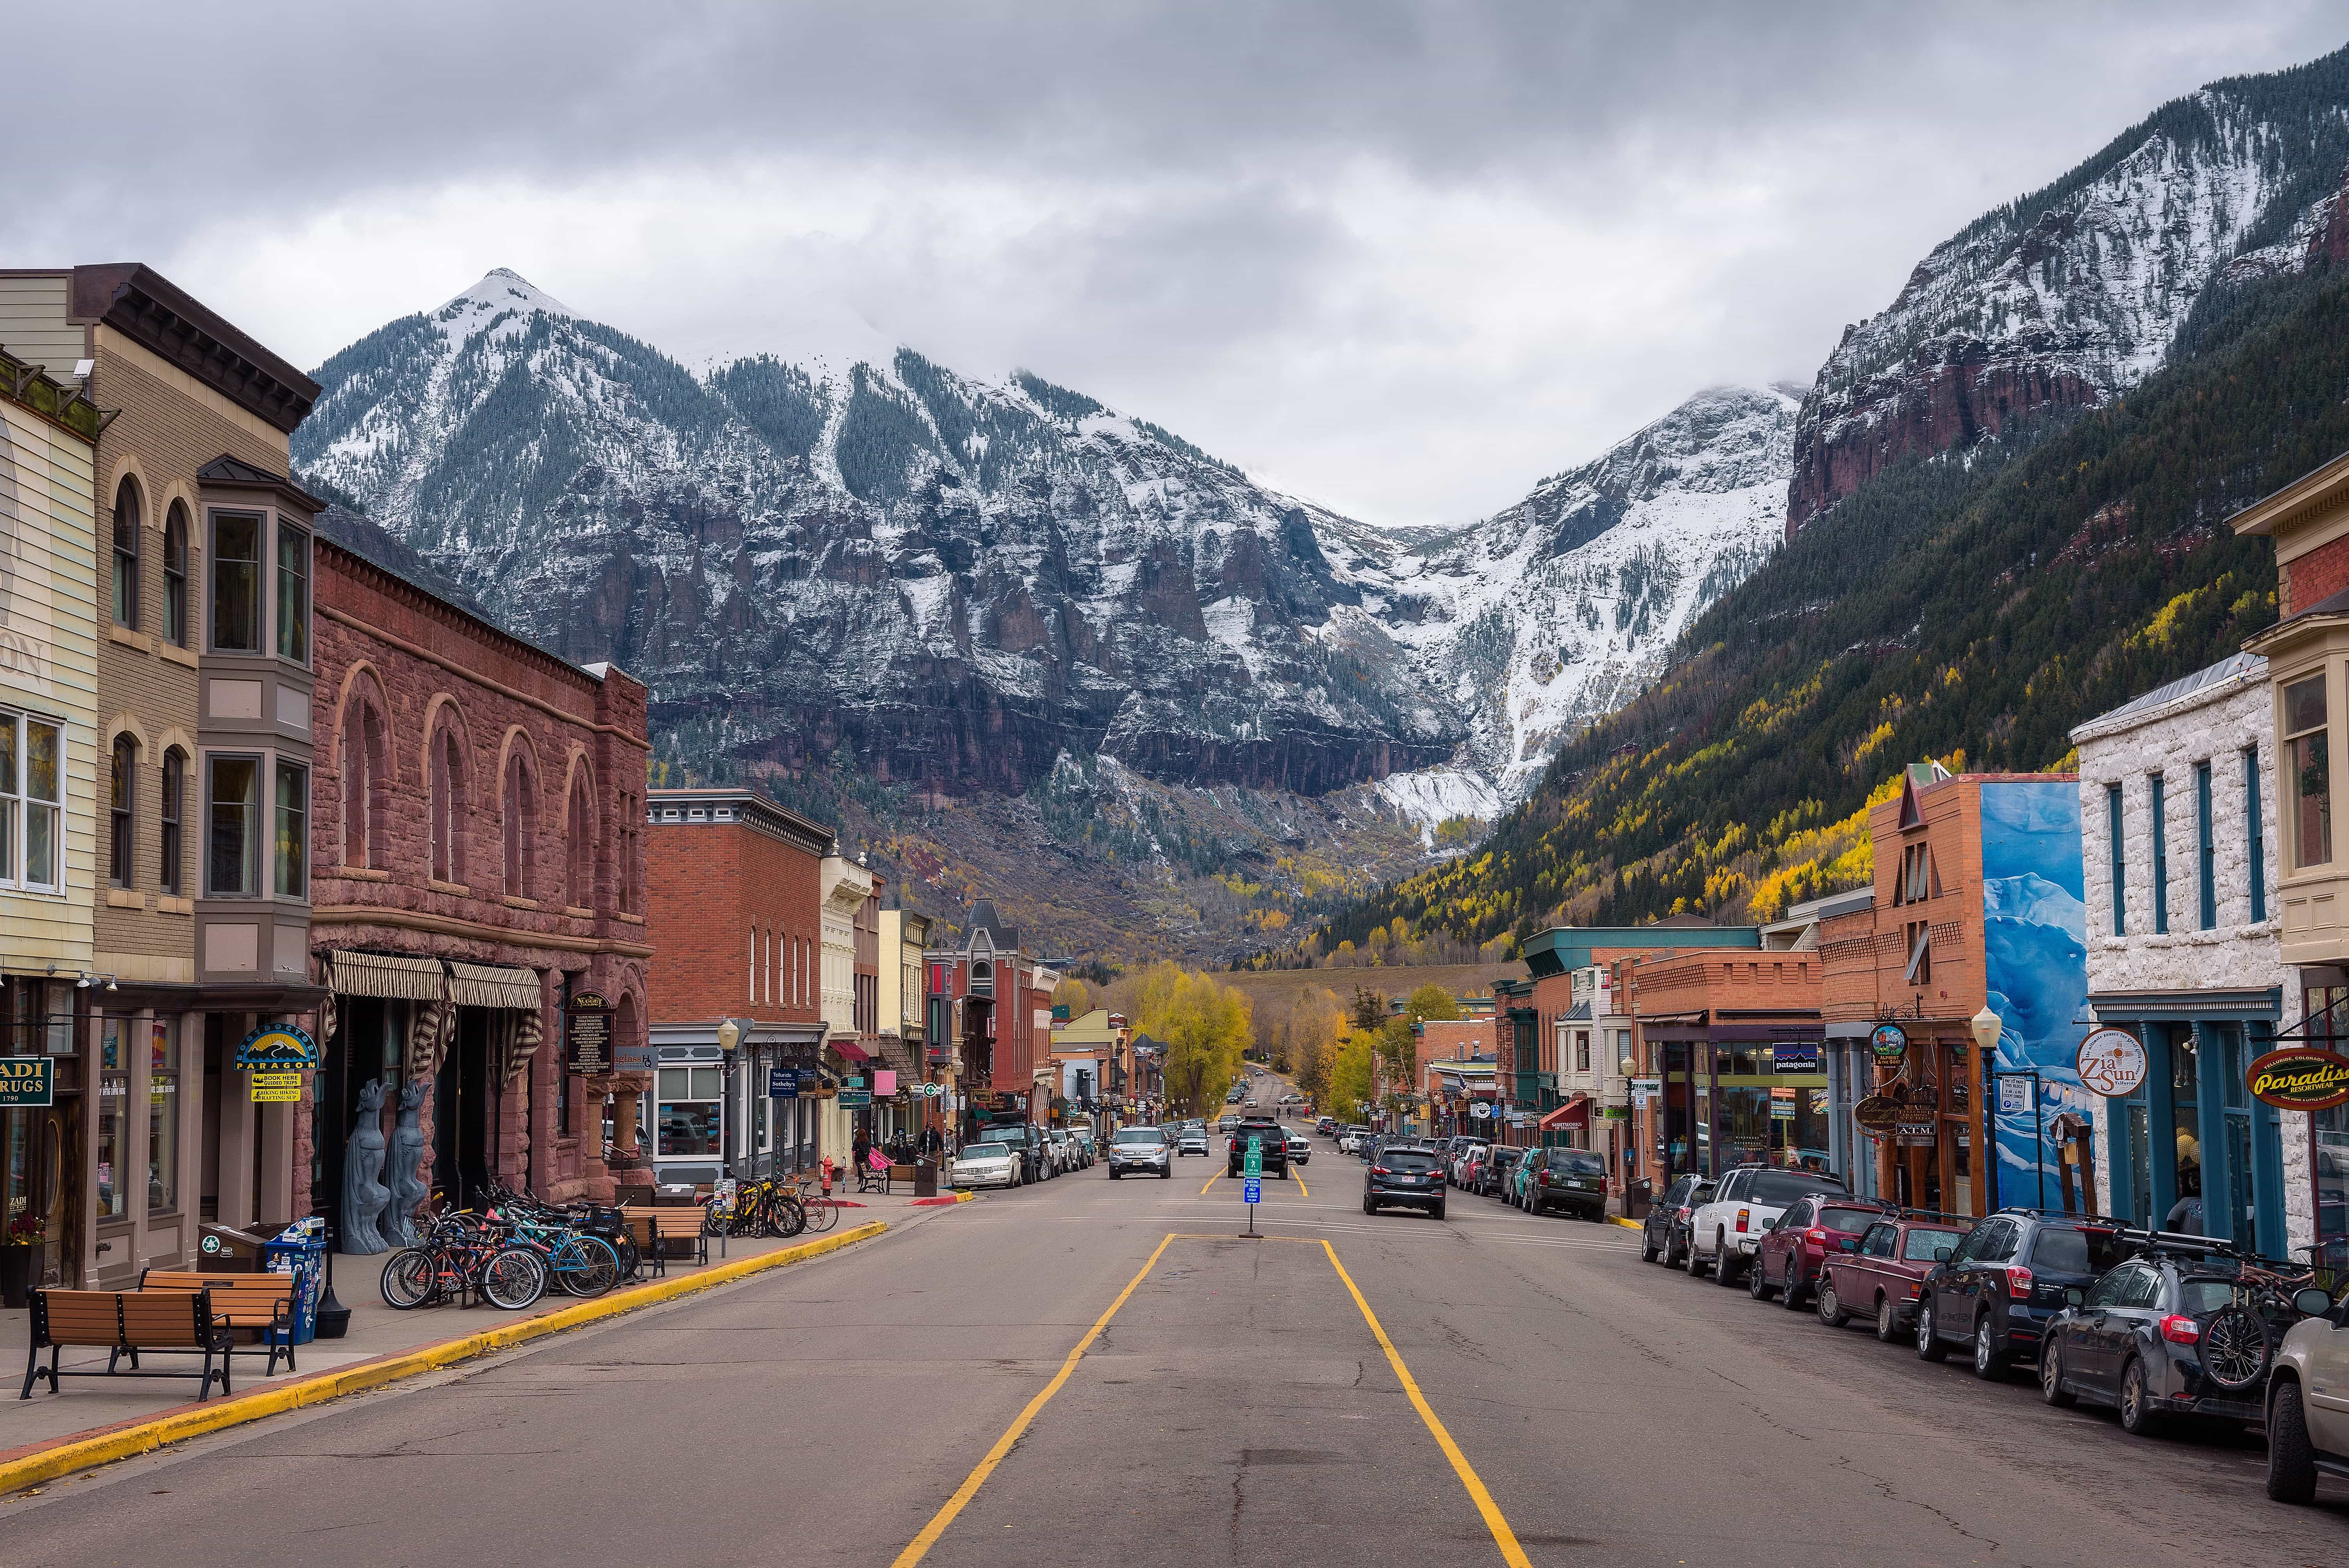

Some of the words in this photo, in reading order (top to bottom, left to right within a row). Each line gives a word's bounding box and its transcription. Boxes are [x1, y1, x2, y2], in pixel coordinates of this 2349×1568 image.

[577, 998, 602, 1008] NUGGET
[2089, 1035, 2103, 1050] ultimate
[2126, 1037, 2137, 1049] great
[2080, 1054, 2116, 1080] Zia
[2263, 1057, 2294, 1070] TELLURIDE,
[0, 1080, 43, 1092] RUGS
[2100, 1069, 2137, 1091] Sun
[2290, 1082, 2334, 1093] RESORTWEAR
